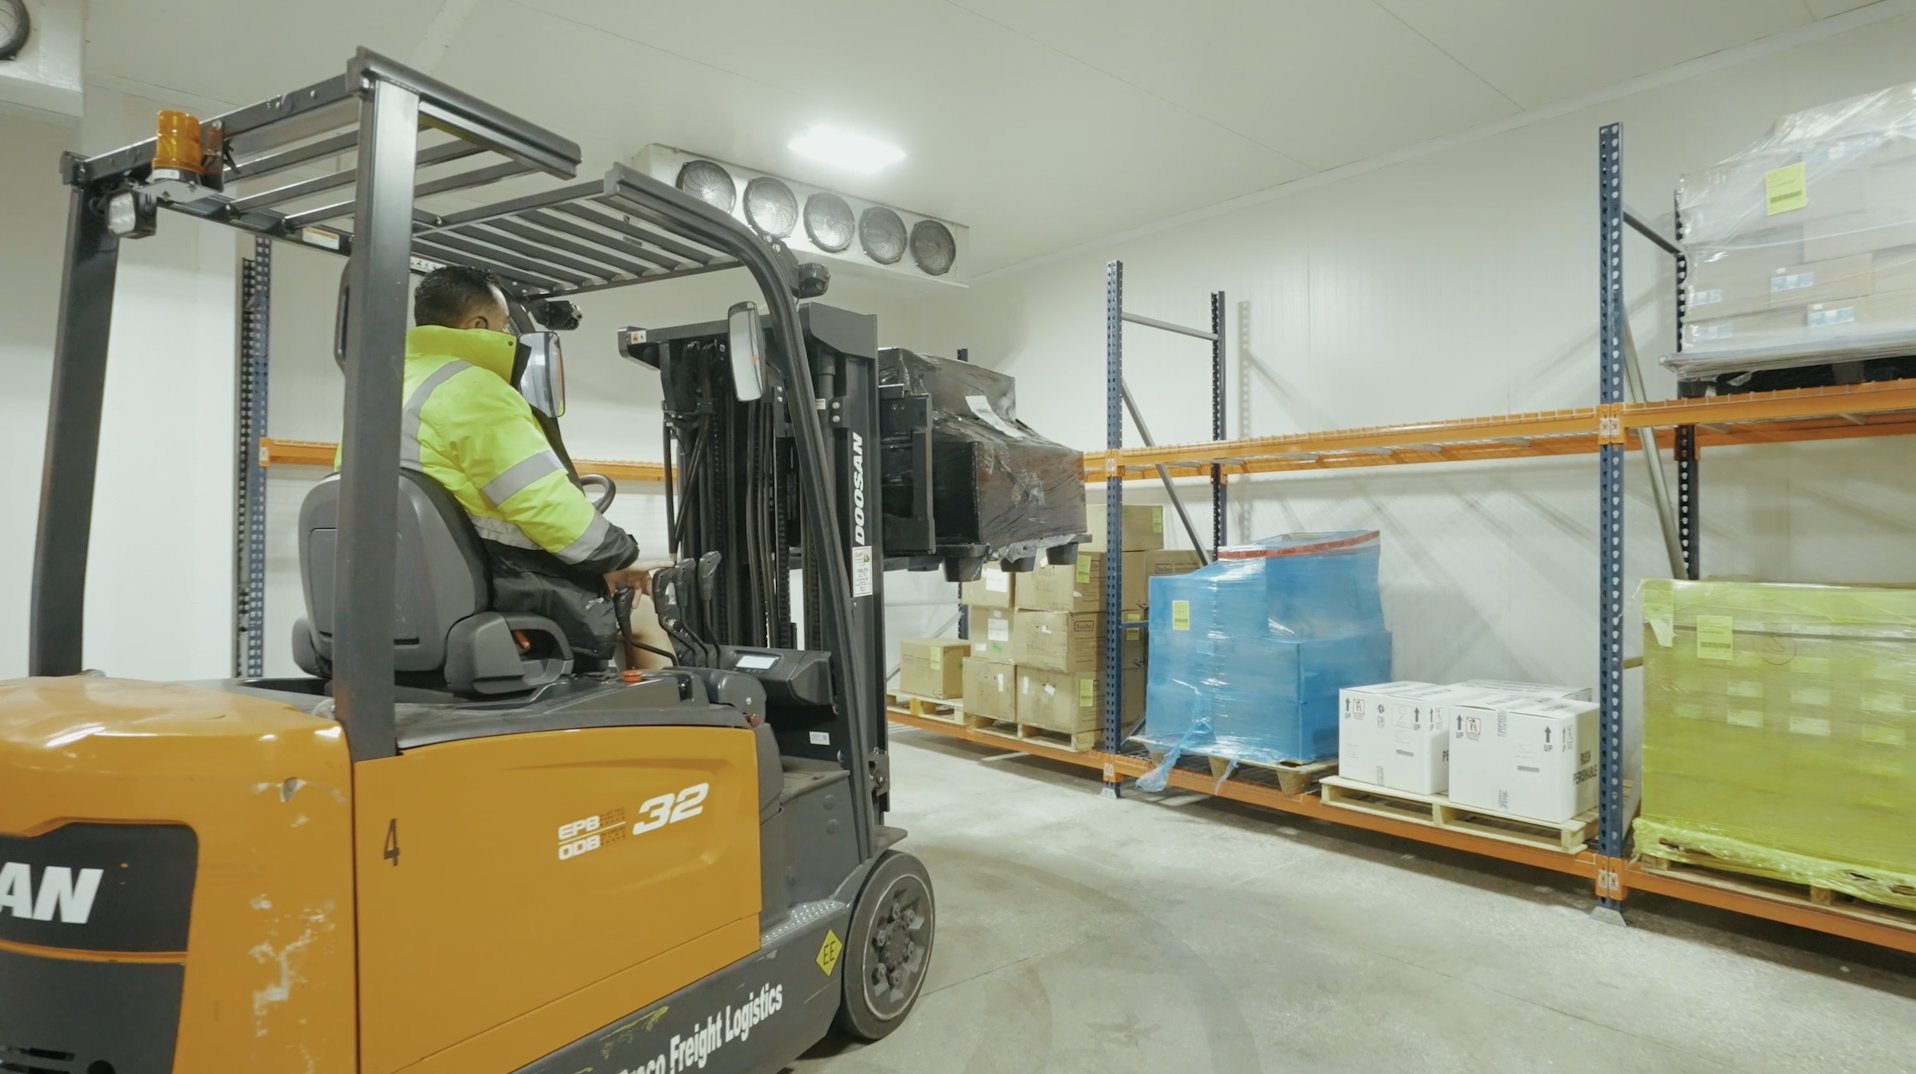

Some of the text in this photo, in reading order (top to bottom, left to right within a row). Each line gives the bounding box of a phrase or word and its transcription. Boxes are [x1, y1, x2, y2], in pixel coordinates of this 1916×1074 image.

[852, 431, 865, 546] DOOSAN
[1544, 744, 1553, 752] UP
[632, 782, 709, 836] 32
[383, 818, 400, 867] 4
[0, 861, 104, 924] AN
[823, 940, 836, 966] EE
[670, 983, 783, 1074] Freight Logistics
